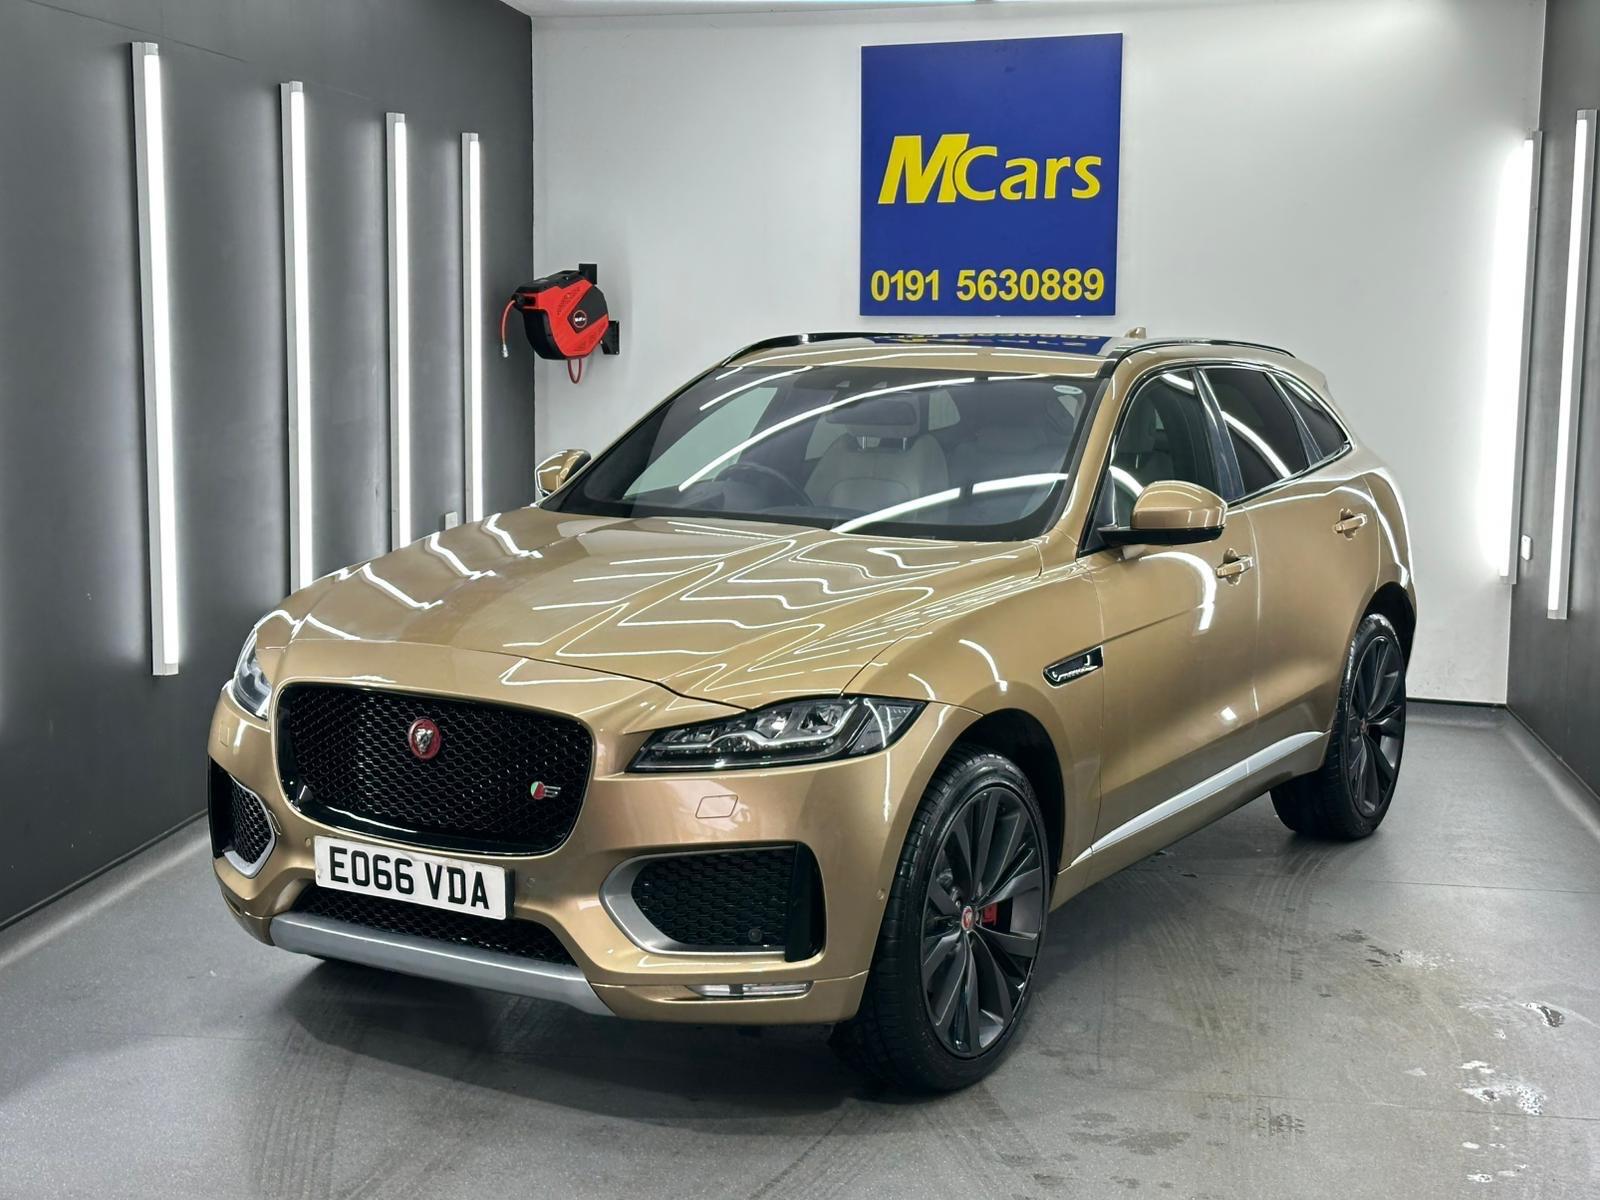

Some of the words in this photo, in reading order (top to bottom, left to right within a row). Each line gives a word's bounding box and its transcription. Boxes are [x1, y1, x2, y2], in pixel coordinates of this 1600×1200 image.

[870, 269, 940, 302] 0191
[956, 267, 1105, 302] 5630889
[424, 862, 490, 910] VDA
